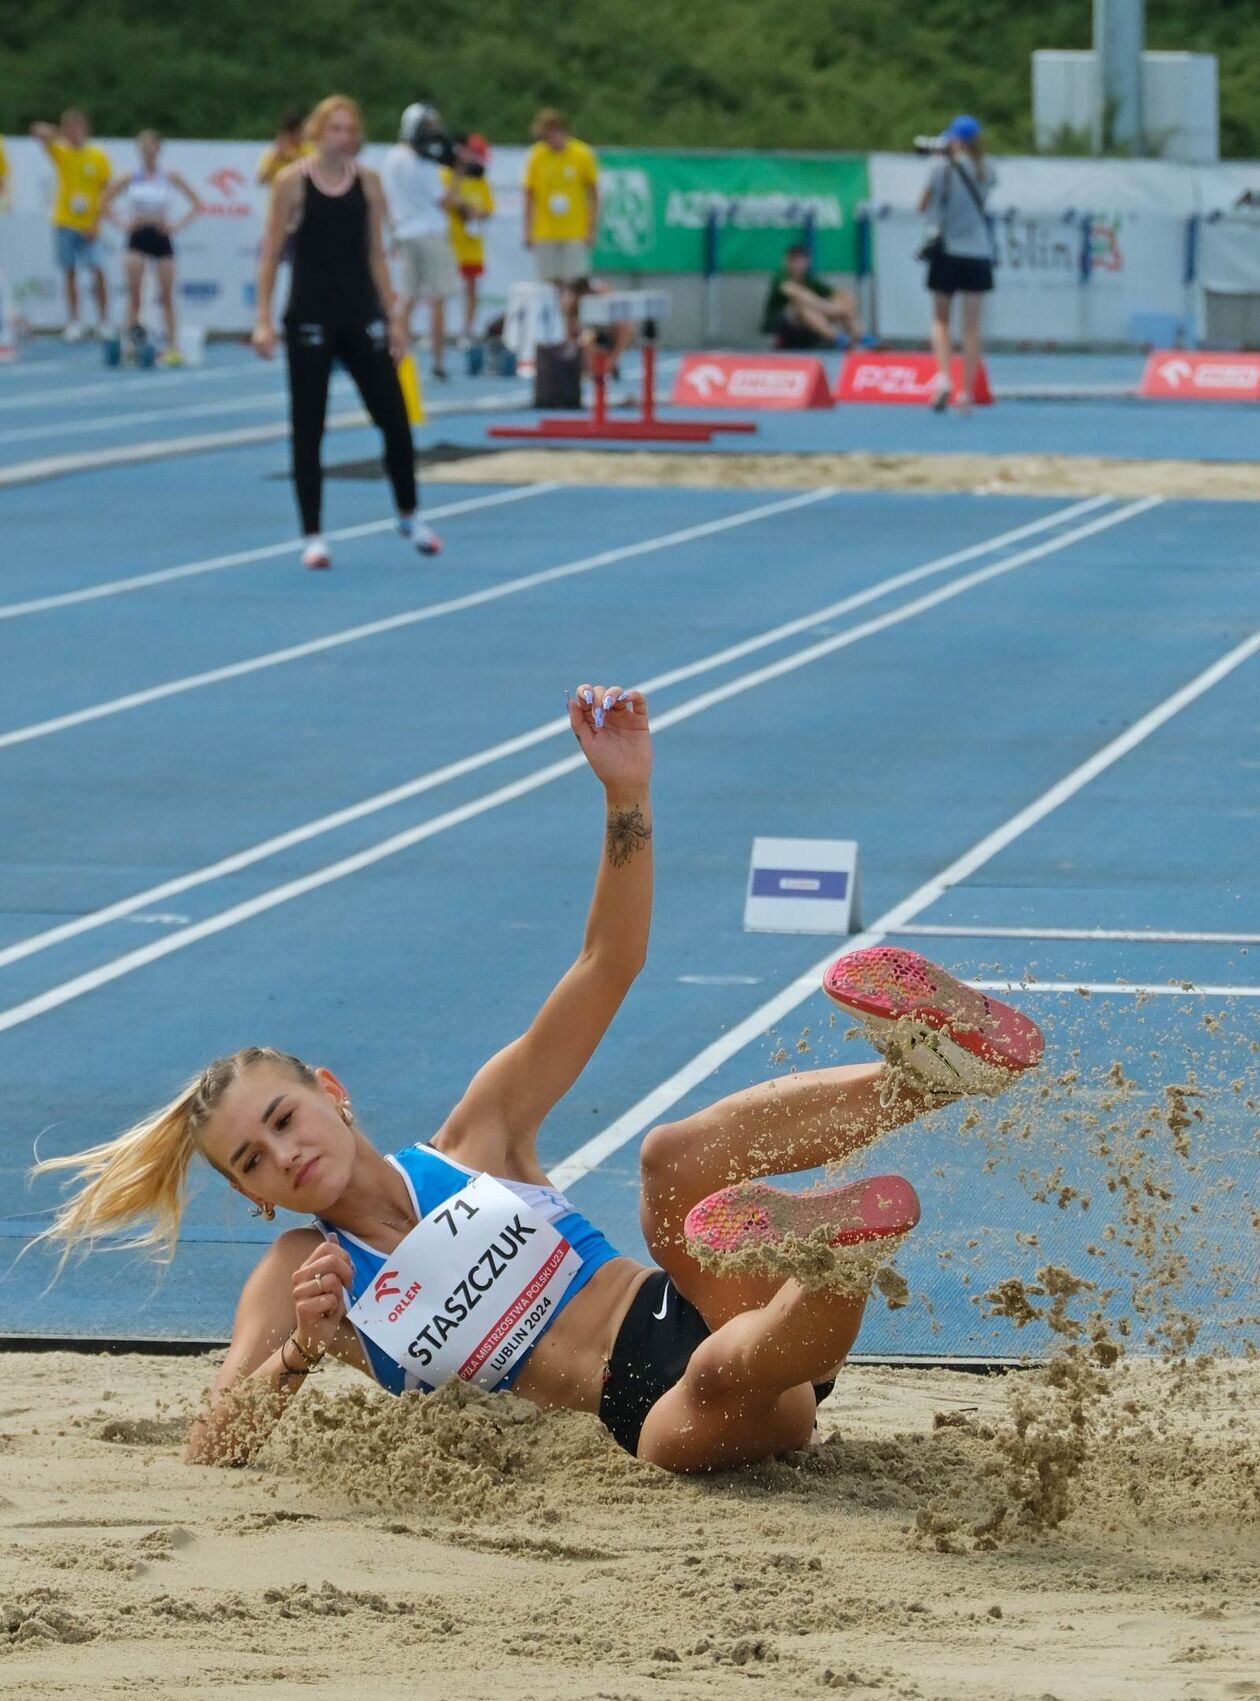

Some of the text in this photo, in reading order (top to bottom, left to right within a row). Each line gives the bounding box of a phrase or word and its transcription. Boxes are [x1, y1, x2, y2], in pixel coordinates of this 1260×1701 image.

[433, 1199, 480, 1237] 71
[387, 1281, 422, 1322] ORLEN
[407, 1213, 537, 1367] STASZCZUK
[475, 1298, 530, 1358] MISTRZOSTWA
[526, 1266, 552, 1299] POLSKI
[551, 1249, 565, 1269] U23
[490, 1297, 552, 1371] LUBLIN 2024
